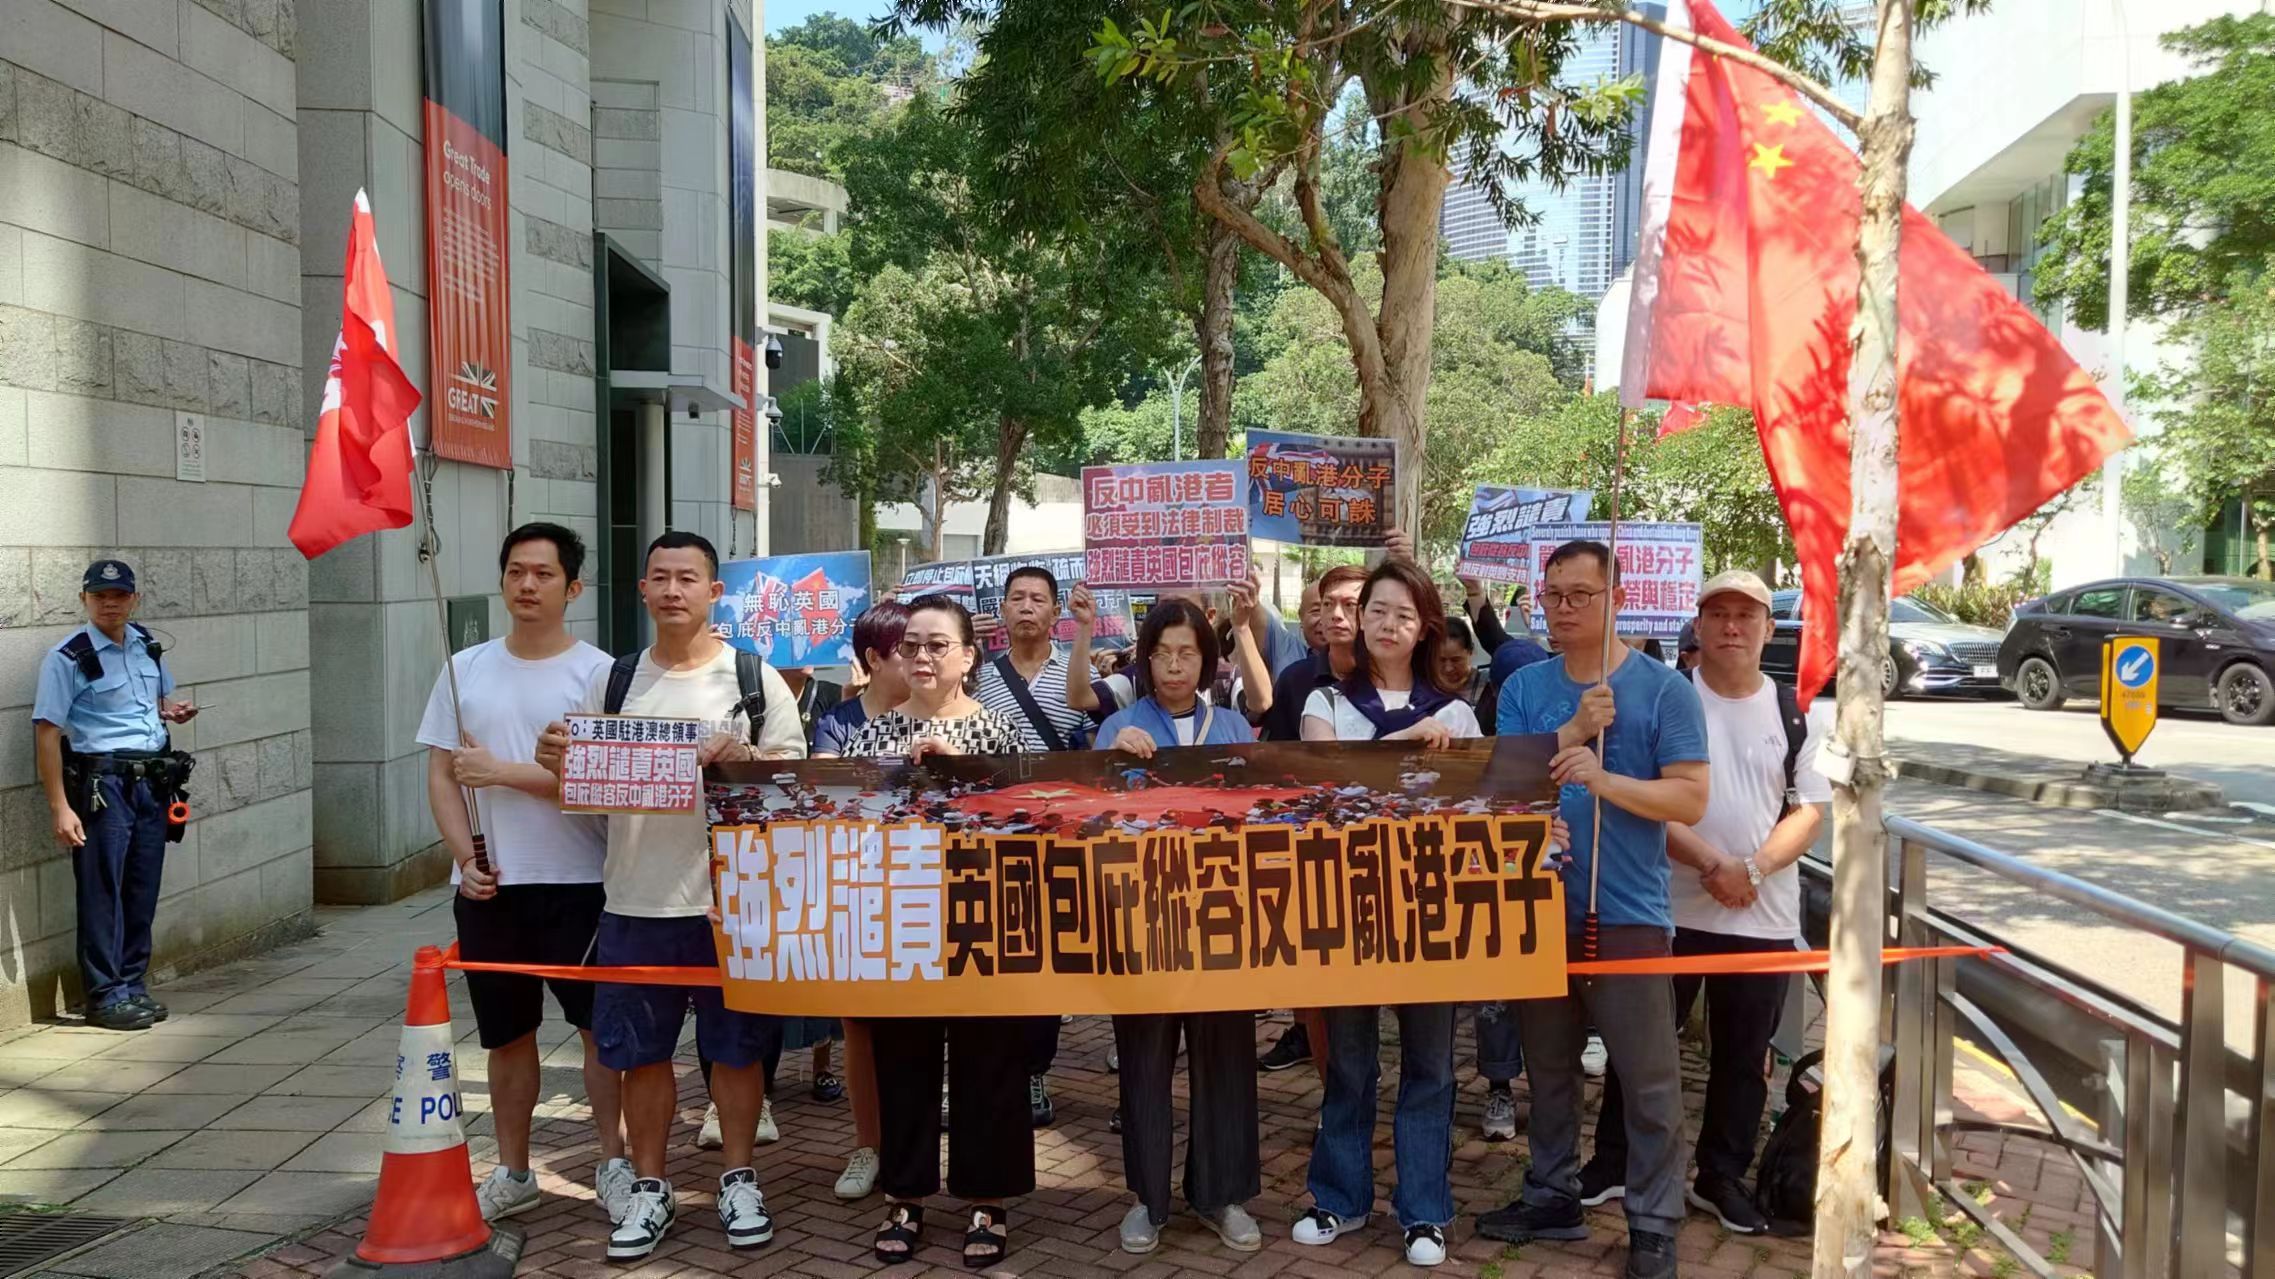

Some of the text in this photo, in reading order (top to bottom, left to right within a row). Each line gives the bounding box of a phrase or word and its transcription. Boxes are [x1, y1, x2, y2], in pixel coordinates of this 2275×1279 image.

[443, 139, 491, 185] Great Trade
[443, 170, 491, 211] opens doors
[447, 386, 479, 415] GREAT
[1092, 472, 1235, 508] 反中亂港者
[1251, 456, 1391, 493] 反中亂港分子
[1086, 508, 1246, 540] 必須受到法律制裁
[1263, 490, 1376, 525] 居心可誅
[1086, 545, 1246, 585] 強烈譴責英國包庇縱容
[743, 589, 840, 614] 無恥英國
[1653, 619, 1669, 633] and
[565, 744, 698, 783] 強烈譴責英國
[564, 781, 694, 809] 包庇縱容反中亂港分子
[716, 820, 1553, 983] 強烈譴責英國包庇縱容反中亂港分子
[426, 1052, 452, 1081] 警
